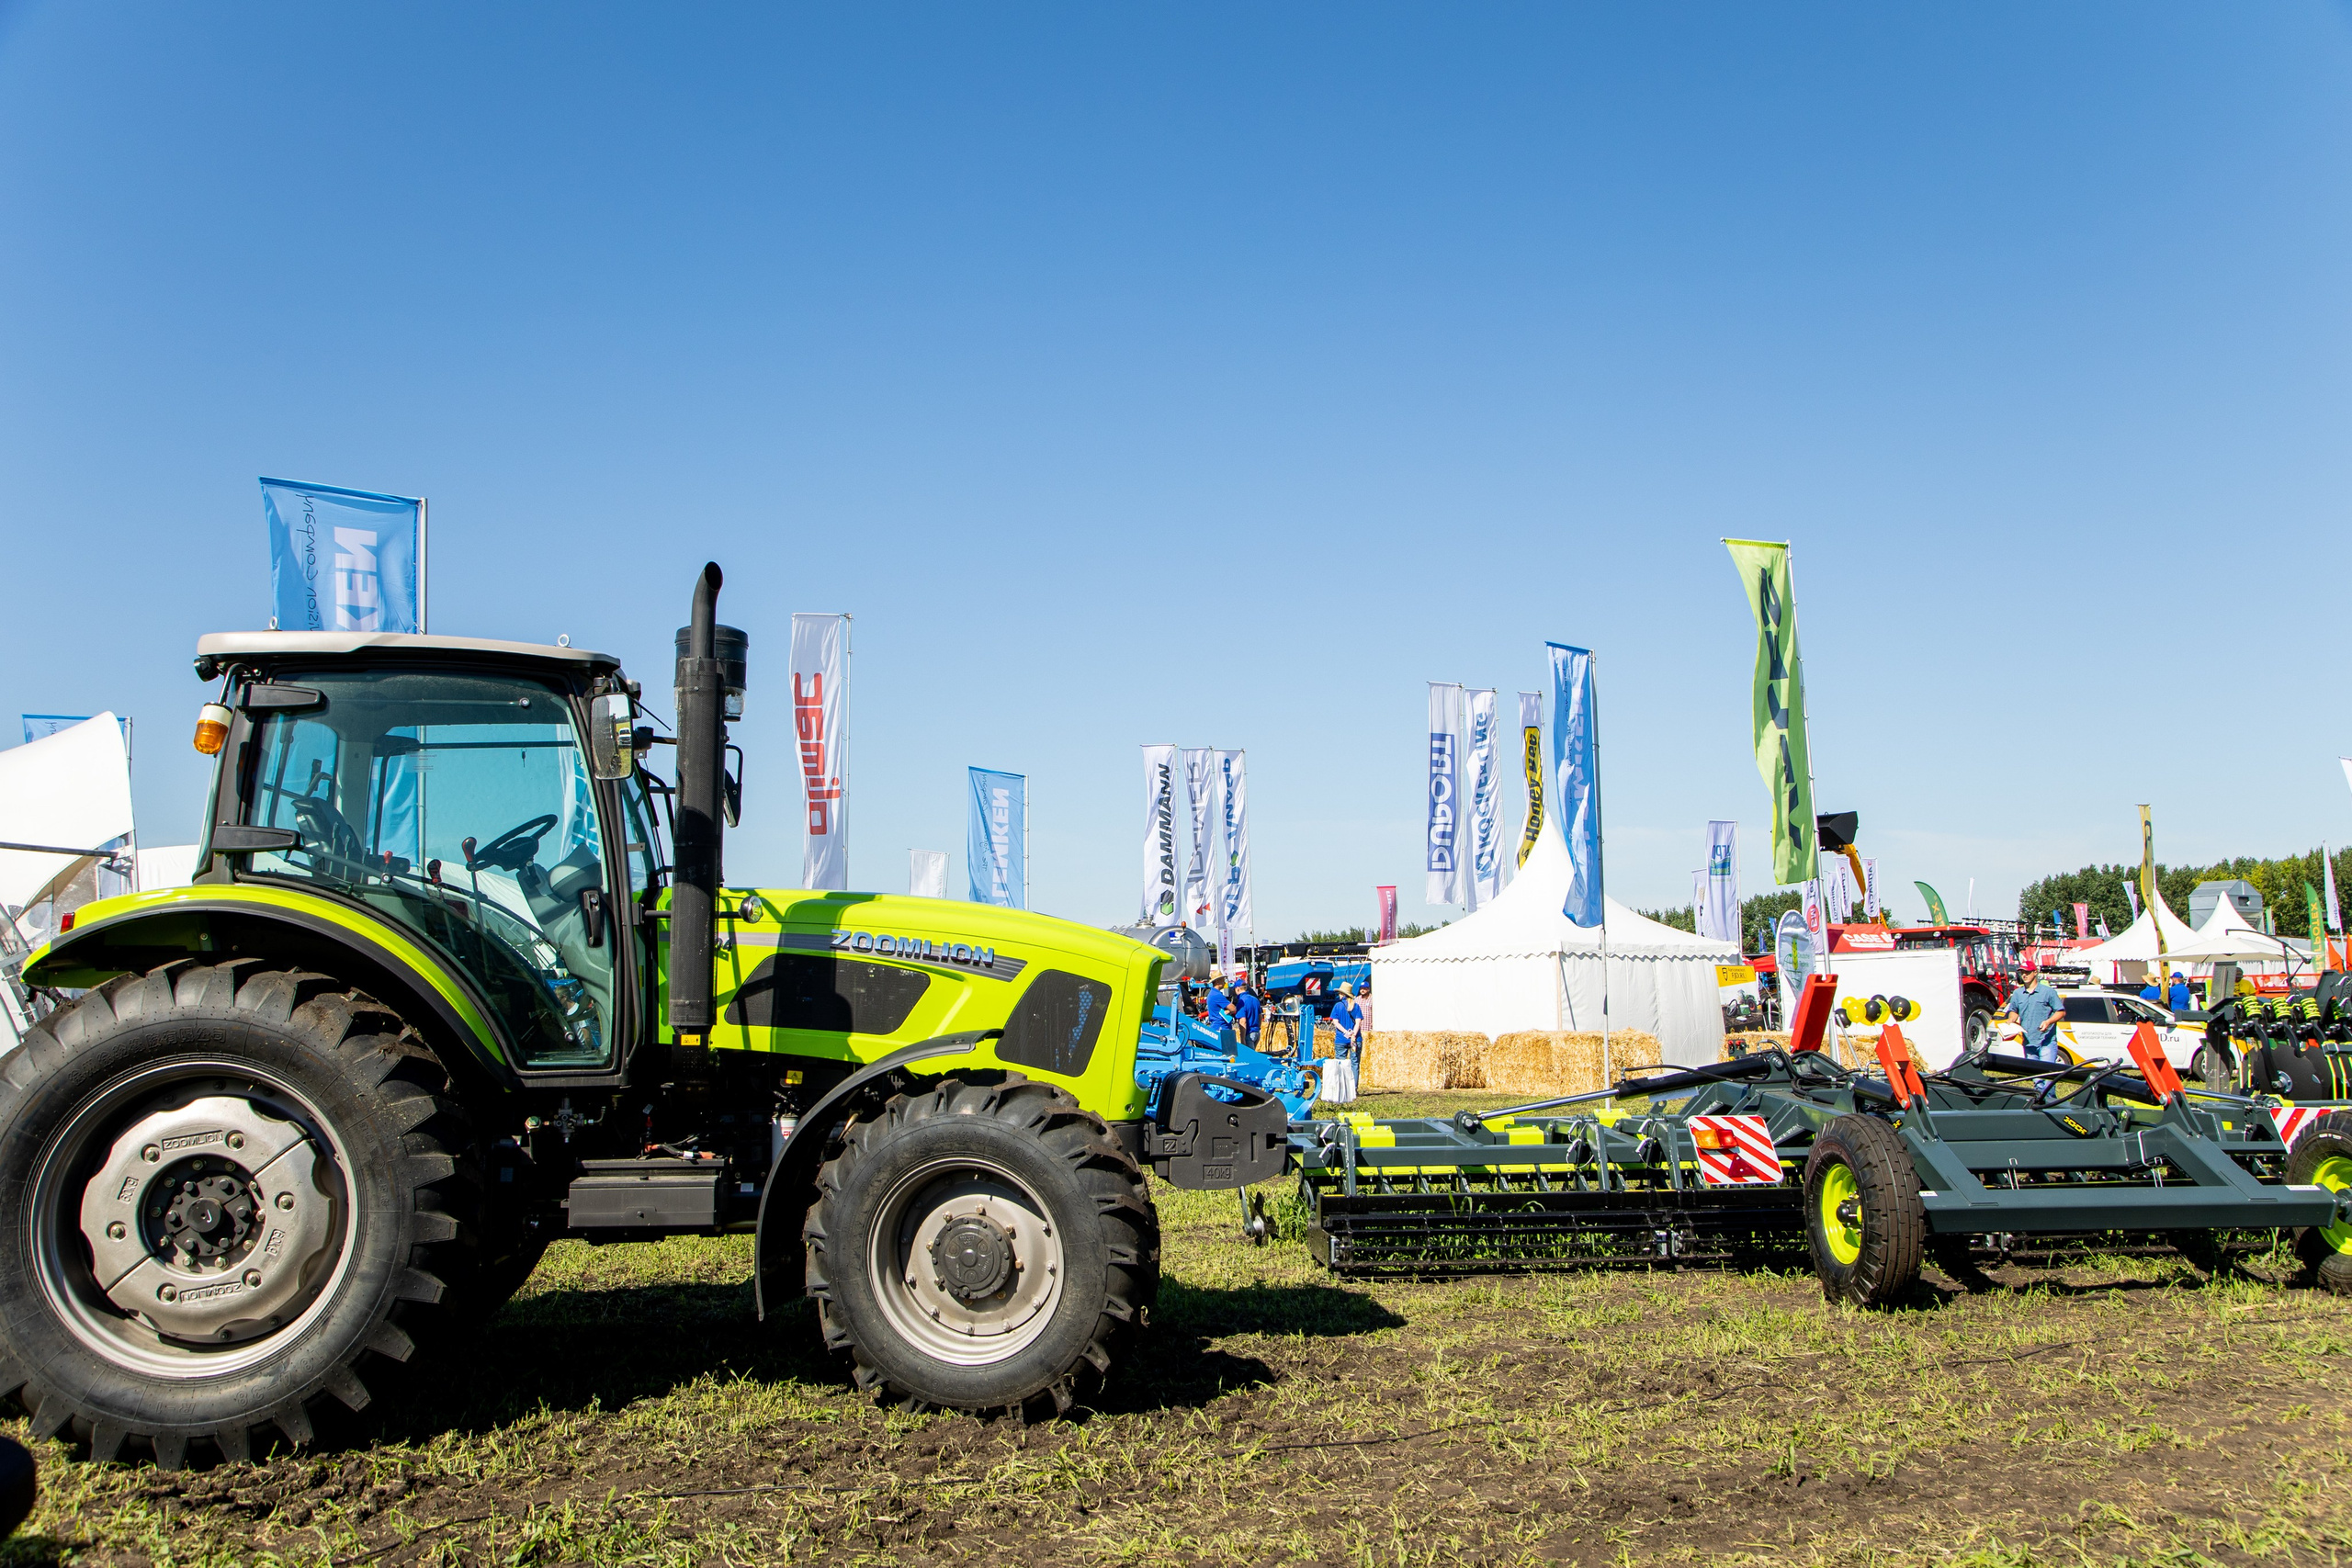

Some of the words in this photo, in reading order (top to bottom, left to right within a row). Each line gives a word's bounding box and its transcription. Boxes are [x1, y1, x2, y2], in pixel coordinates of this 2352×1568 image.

[1526, 776, 1540, 842] Honey
[1158, 763, 1175, 886] DAMMANN
[1842, 932, 1881, 943] CASE
[830, 929, 995, 969] ZOOMLION
[2157, 1033, 2179, 1043] D.ru
[164, 1133, 223, 1149] ZOOMLION
[1206, 1168, 1231, 1179] 40kg
[181, 1283, 242, 1302] ZOOMLION
